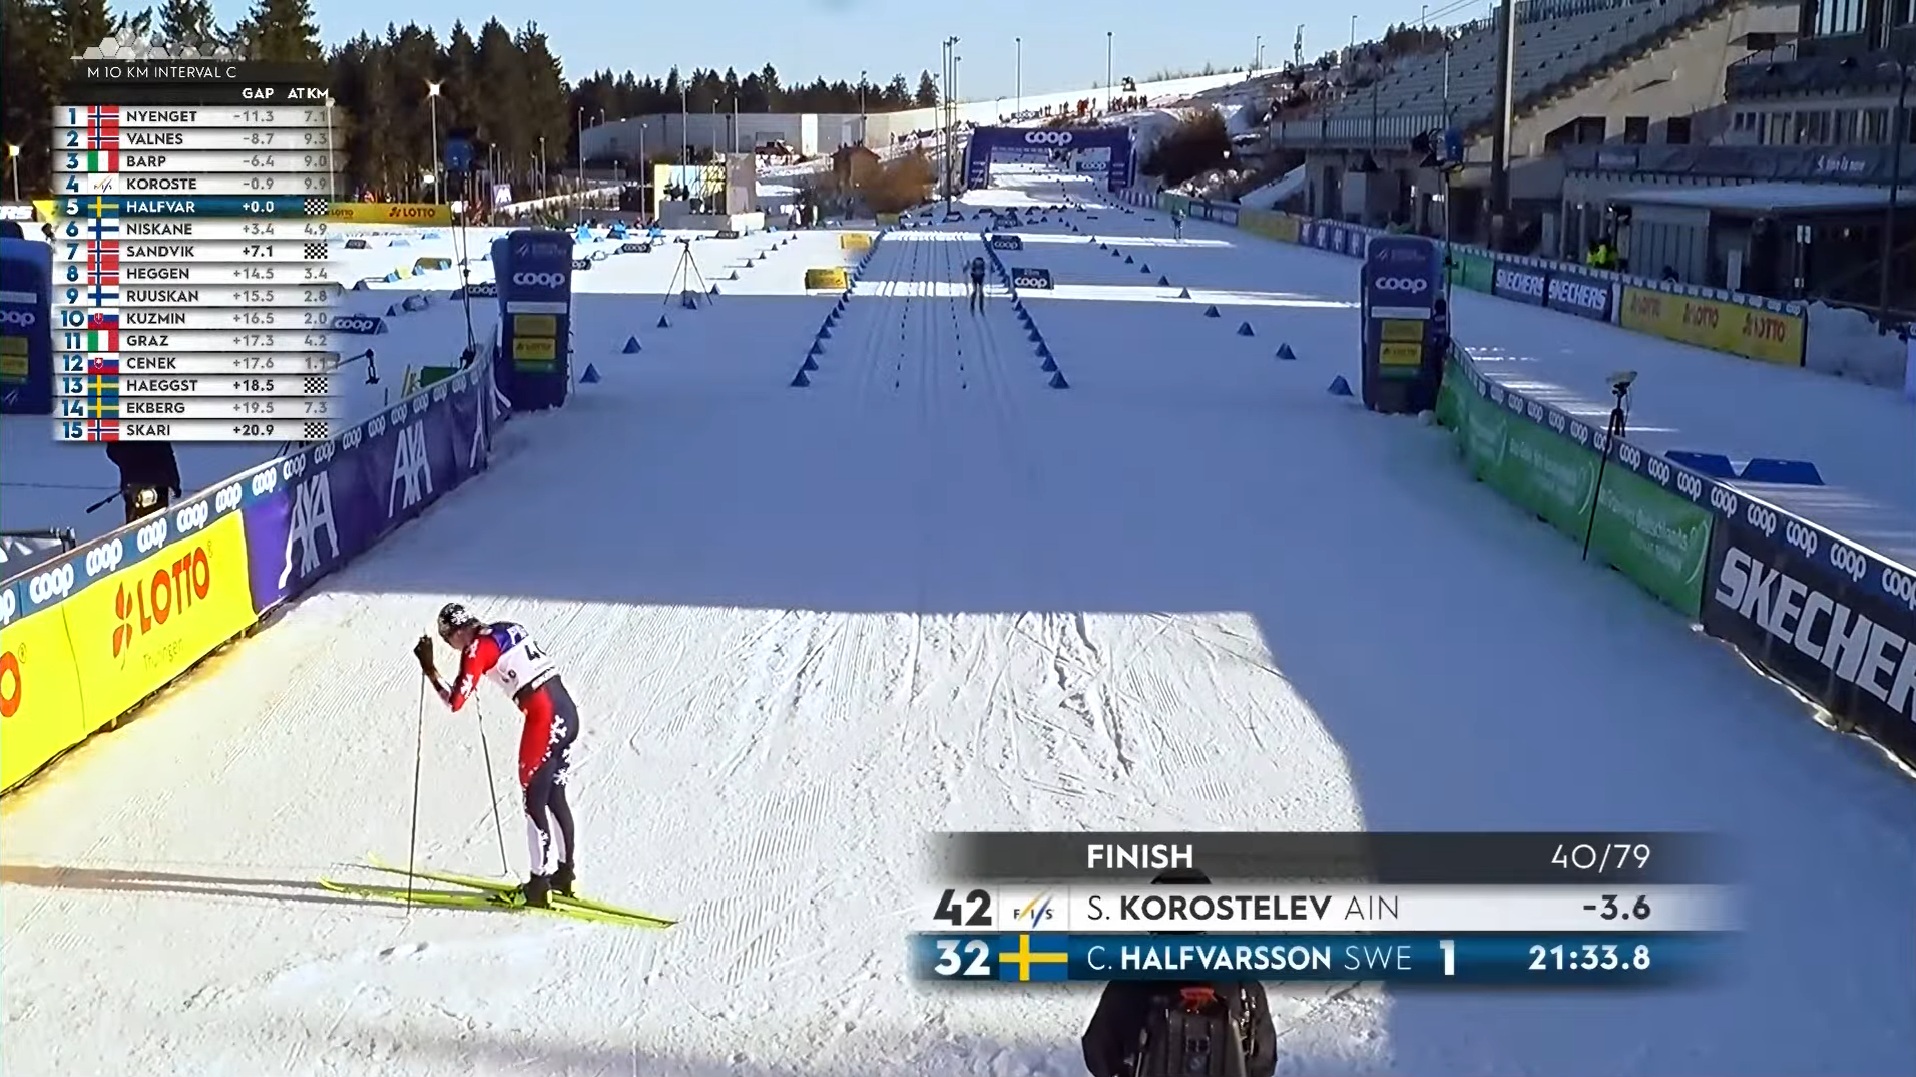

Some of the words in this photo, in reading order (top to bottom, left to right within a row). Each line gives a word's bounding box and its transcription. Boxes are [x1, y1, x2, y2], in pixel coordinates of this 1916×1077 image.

[1025, 131, 1072, 146] coop
[1081, 162, 1106, 170] coop
[331, 209, 353, 217] LOTTO
[403, 208, 436, 218] LOTTO
[624, 243, 647, 253] coop
[513, 272, 565, 289] coop
[1015, 277, 1047, 289] coop
[1375, 277, 1427, 294] coop
[1495, 268, 1545, 297] SKECHERS
[1548, 278, 1608, 310] SKECHERS
[334, 318, 373, 331] coop
[389, 419, 433, 518] AXA
[30, 563, 74, 604] coop
[86, 538, 123, 577] coop
[137, 516, 168, 553] coop
[176, 500, 209, 533] coop
[215, 482, 241, 513] coop
[252, 467, 277, 496] coop
[283, 453, 307, 480] coop
[314, 438, 336, 466] coop
[342, 426, 362, 450] coop
[367, 414, 386, 438] coop
[1570, 420, 1589, 445] coop
[1619, 442, 1641, 471] coop
[1648, 456, 1670, 486] coop
[1677, 471, 1702, 502] coop
[1711, 485, 1737, 518] coop
[1747, 503, 1777, 537] coop
[1786, 521, 1818, 557] coop
[1830, 541, 1867, 582] coop
[278, 470, 340, 590] AXA
[137, 546, 210, 636] LOTTO
